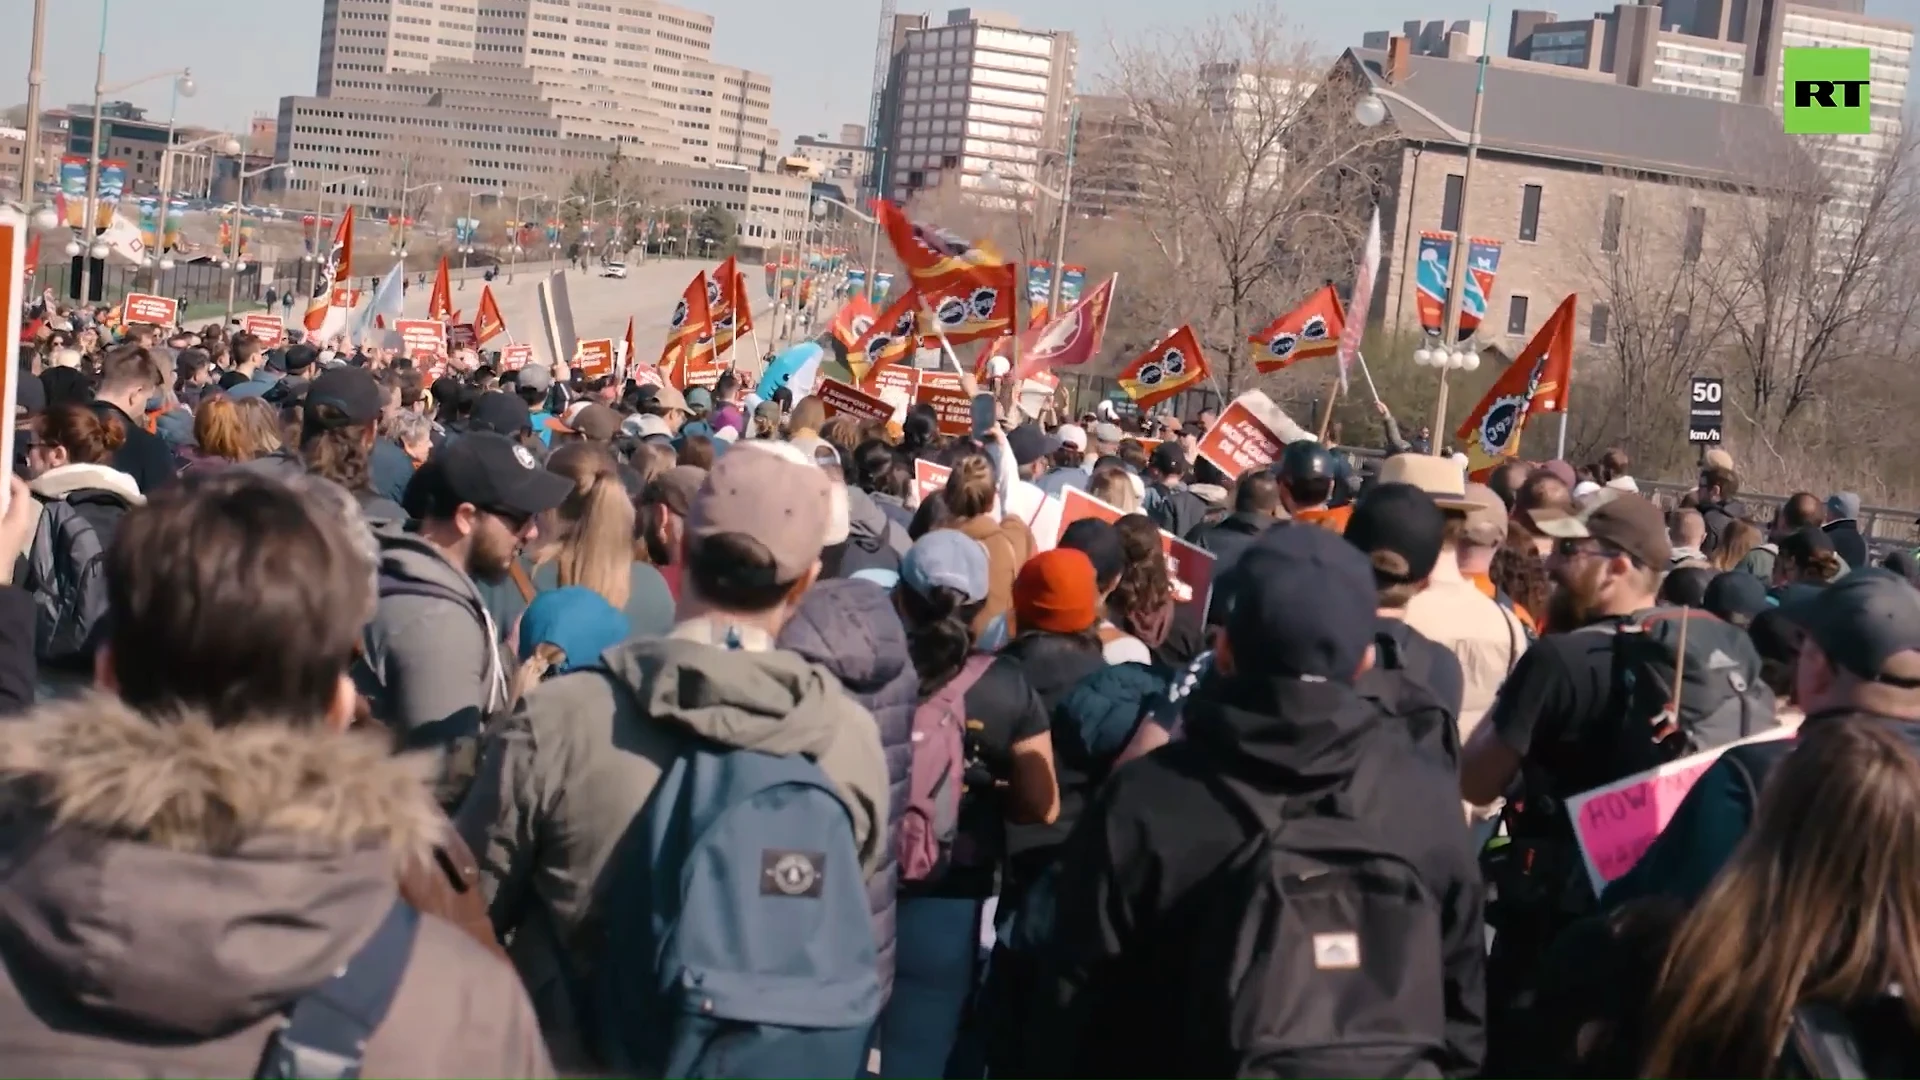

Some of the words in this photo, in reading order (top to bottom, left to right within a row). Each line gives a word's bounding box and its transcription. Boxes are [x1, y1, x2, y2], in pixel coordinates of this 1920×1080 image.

[1692, 382, 1722, 403] 50
[1690, 428, 1720, 441] km/h
[1587, 782, 1647, 830] HOW
